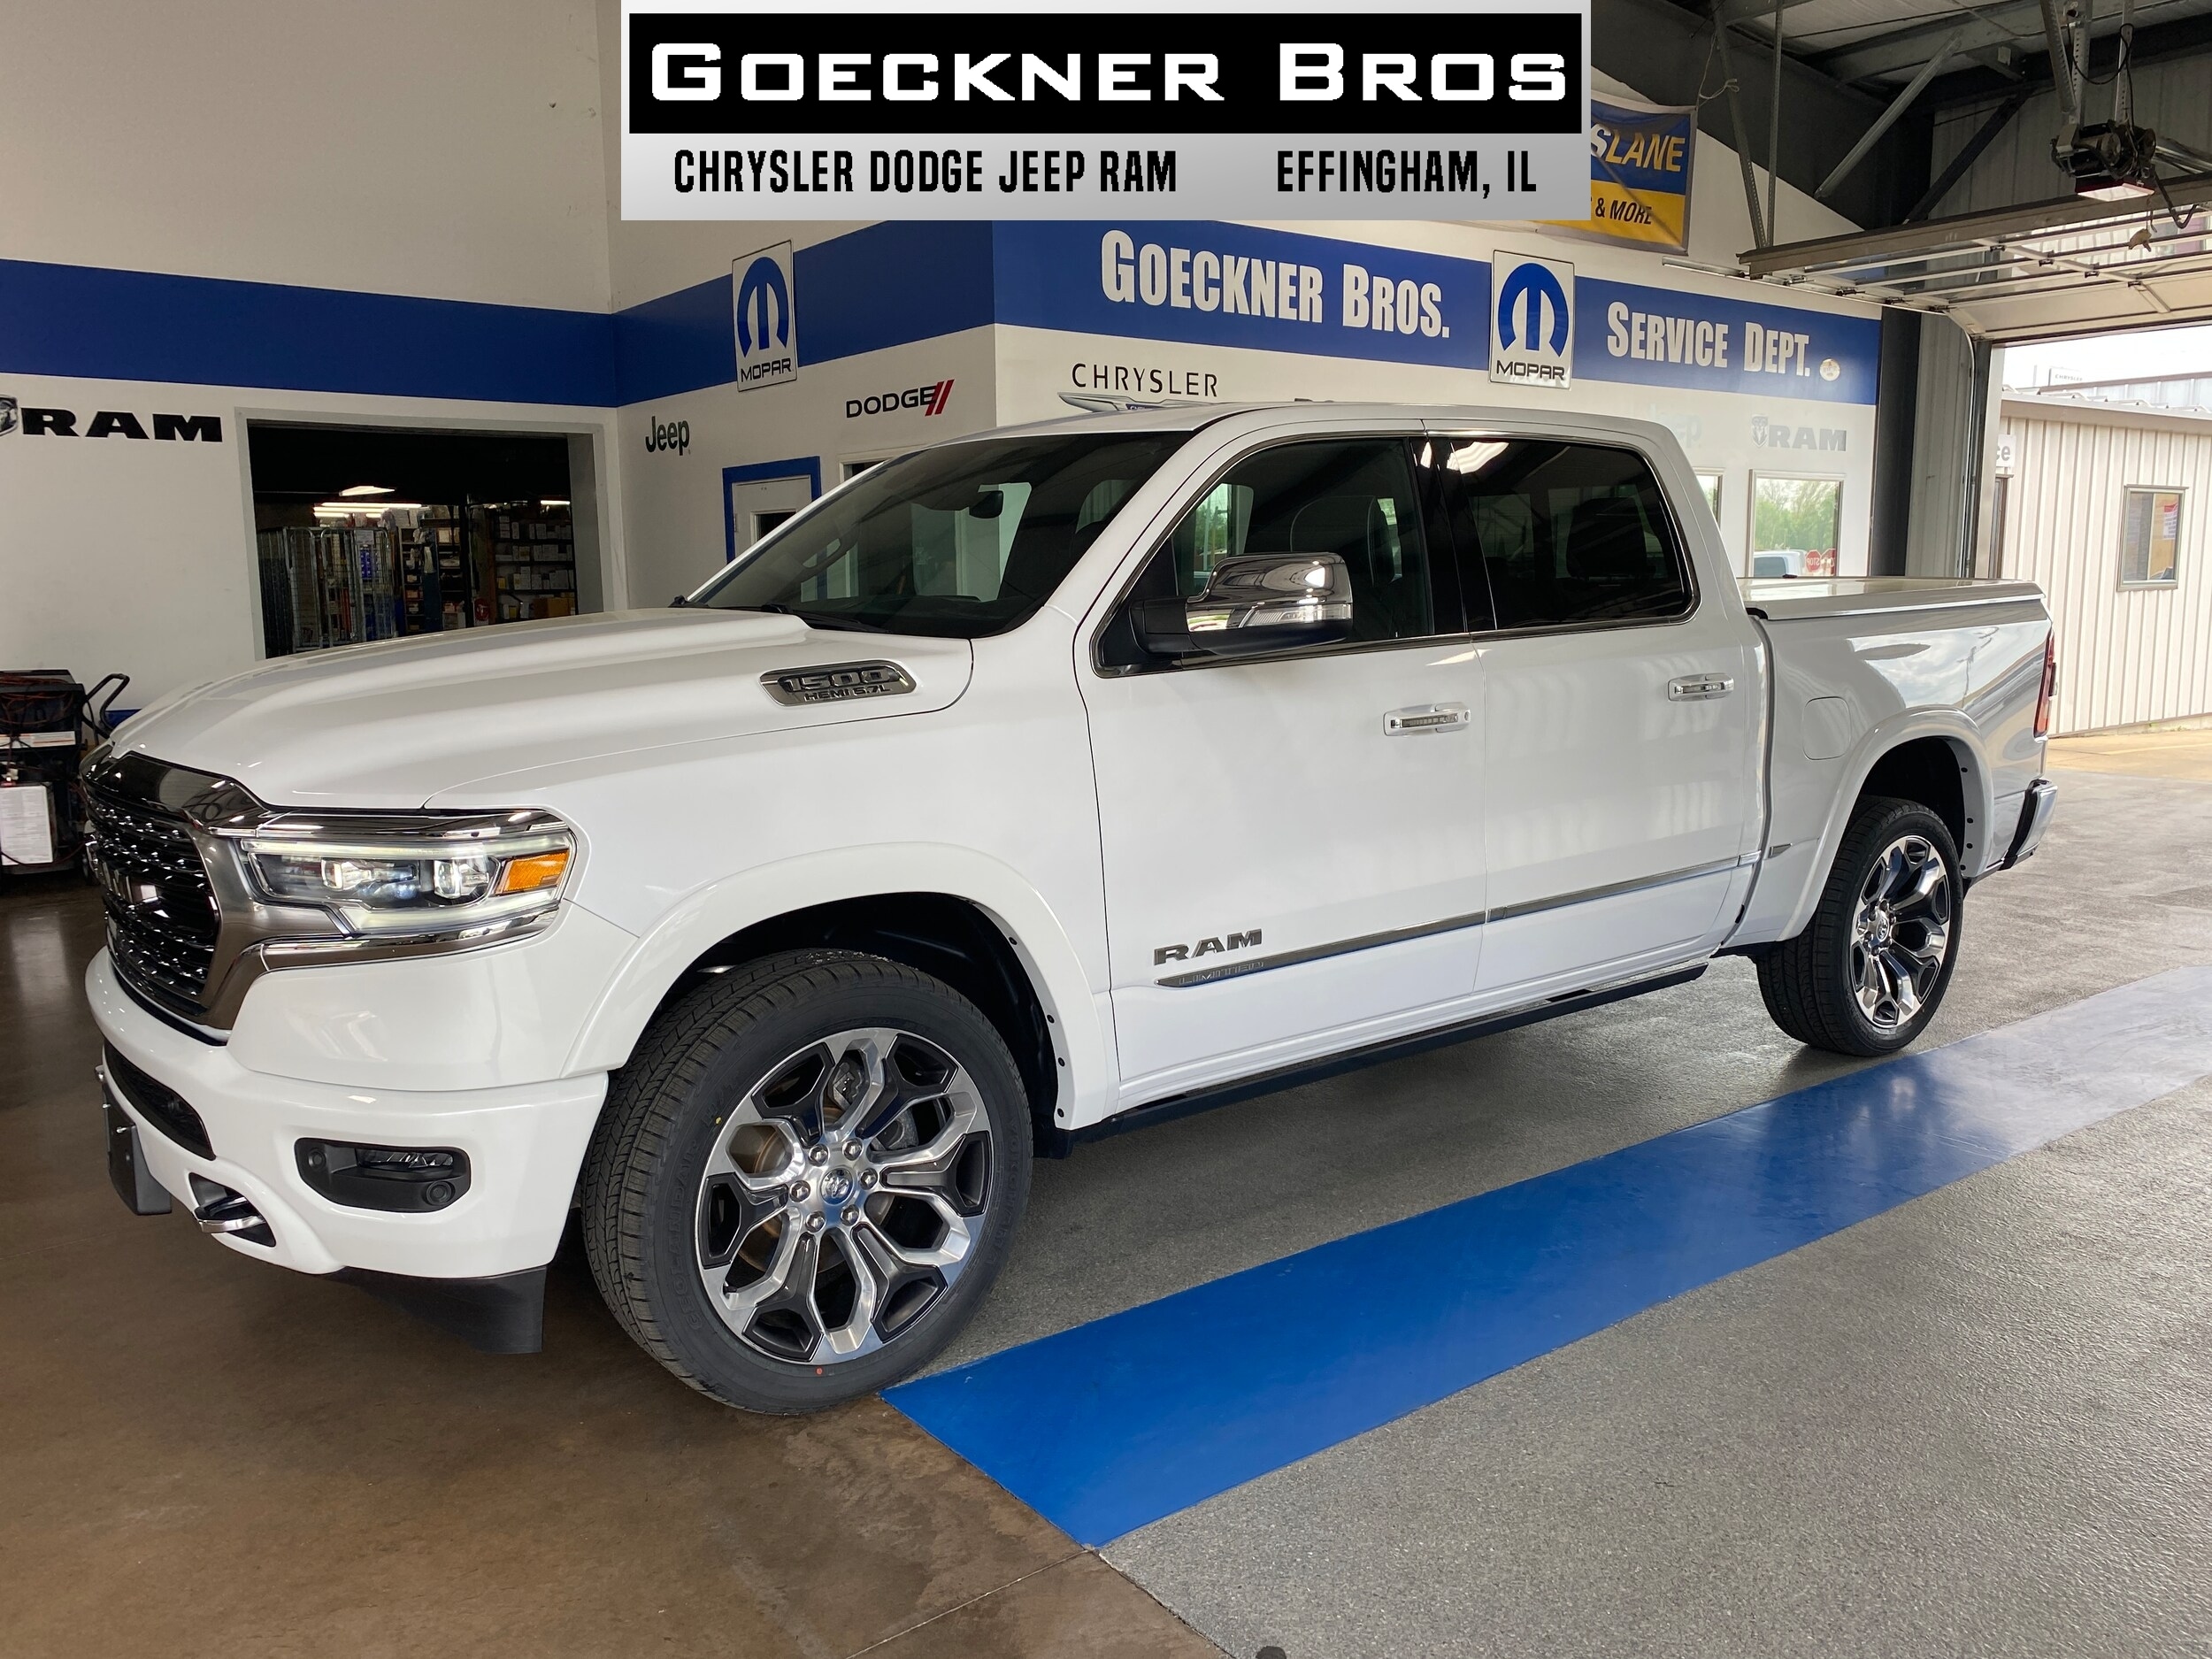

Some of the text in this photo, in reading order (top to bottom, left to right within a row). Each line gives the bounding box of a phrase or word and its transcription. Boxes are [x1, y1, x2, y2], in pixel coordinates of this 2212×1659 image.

[1595, 197, 1605, 218] &
[1101, 229, 1450, 338] GOECKNER BROS.
[1607, 301, 1811, 377] SERVICE DEPT.
[741, 357, 792, 382] MOPAR
[1071, 363, 1217, 397] CHRYSLER
[1495, 359, 1565, 381] MOPAR
[846, 385, 938, 419] DODGE
[20, 407, 223, 442] RAM
[645, 416, 690, 456] Jeep
[1769, 425, 1847, 452] RAM
[784, 669, 891, 692] 1500
[804, 685, 892, 703] HEMI 5.7L
[1154, 928, 1262, 965] RAM
[1179, 961, 1264, 986] LIMITED
